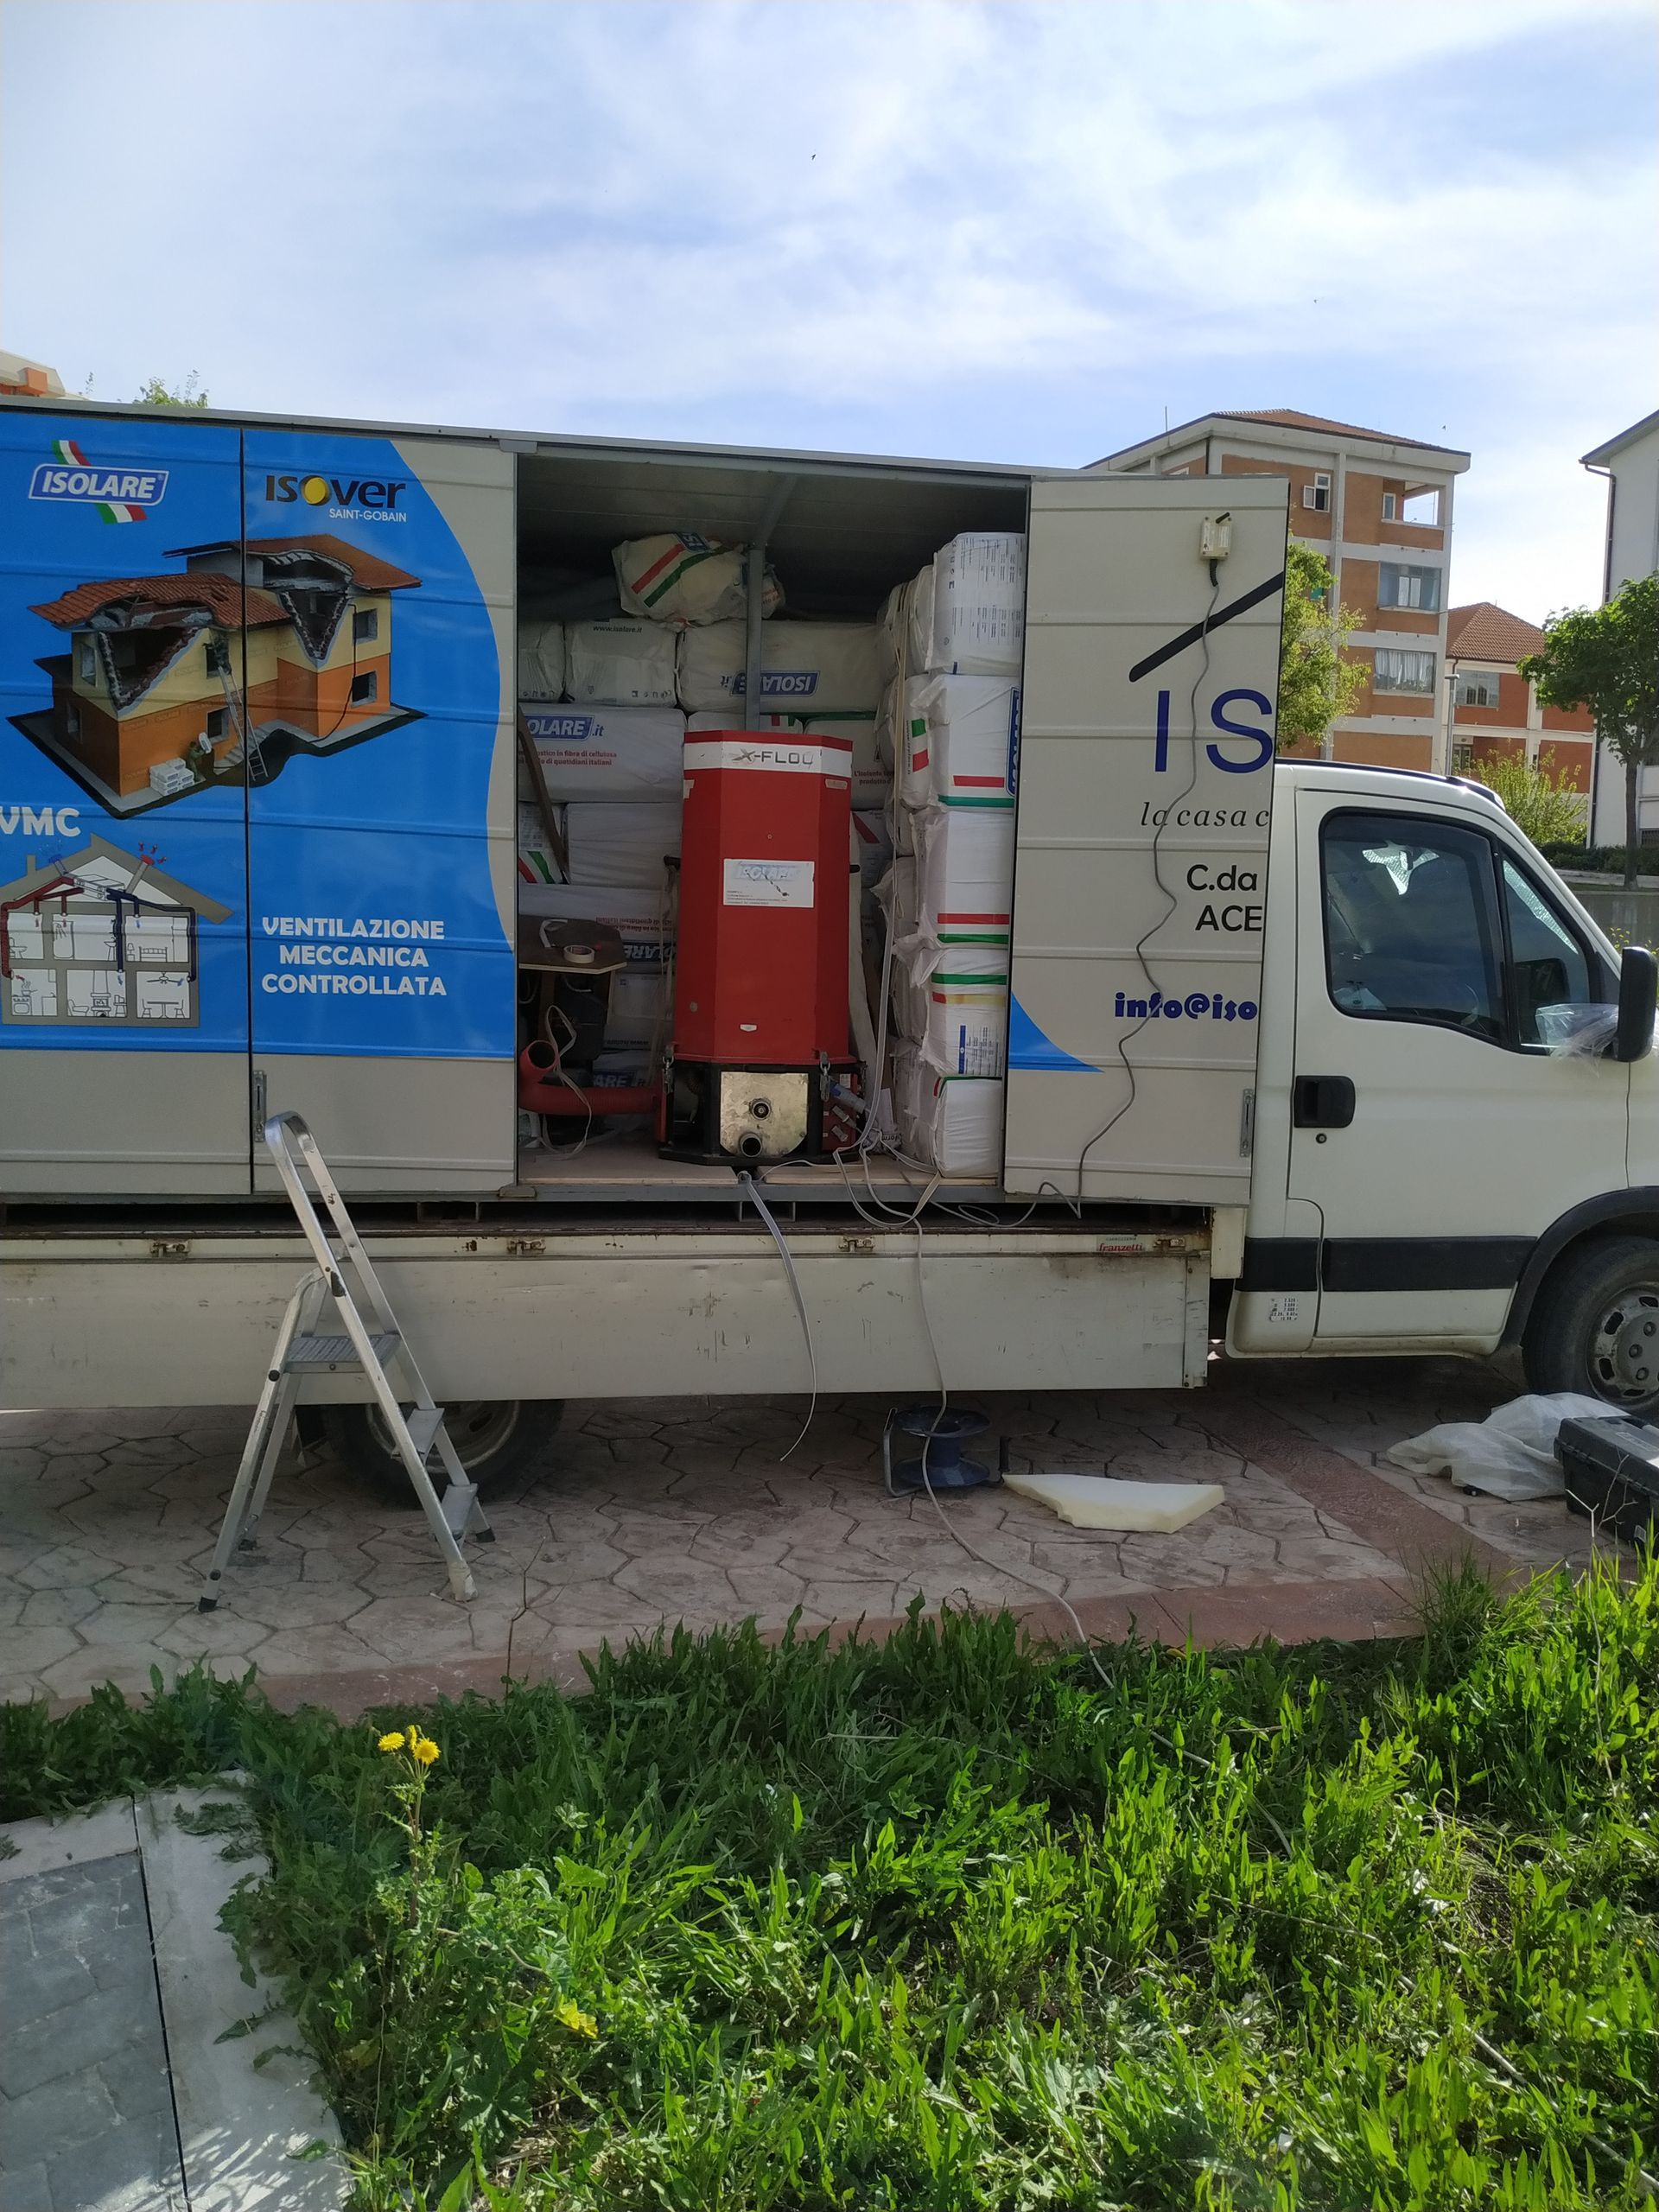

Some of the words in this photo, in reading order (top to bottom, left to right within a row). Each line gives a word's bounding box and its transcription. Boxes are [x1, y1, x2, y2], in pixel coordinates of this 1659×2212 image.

[41, 471, 156, 499] ISOLARE
[329, 508, 407, 523] SAINT-GOBAIN
[593, 625, 643, 634] www.isolare.it
[527, 719, 586, 735] OLARE
[0, 806, 81, 837] VMC
[1141, 801, 1168, 827] la
[1177, 809, 1247, 827] casa
[1186, 864, 1258, 892] C.da
[262, 917, 445, 940] VENTILAZIONE
[1195, 905, 1263, 932] ACE
[279, 945, 429, 968] MECCANICA
[262, 974, 447, 995] CONTROLLATA
[1115, 991, 1258, 1022] info@iso
